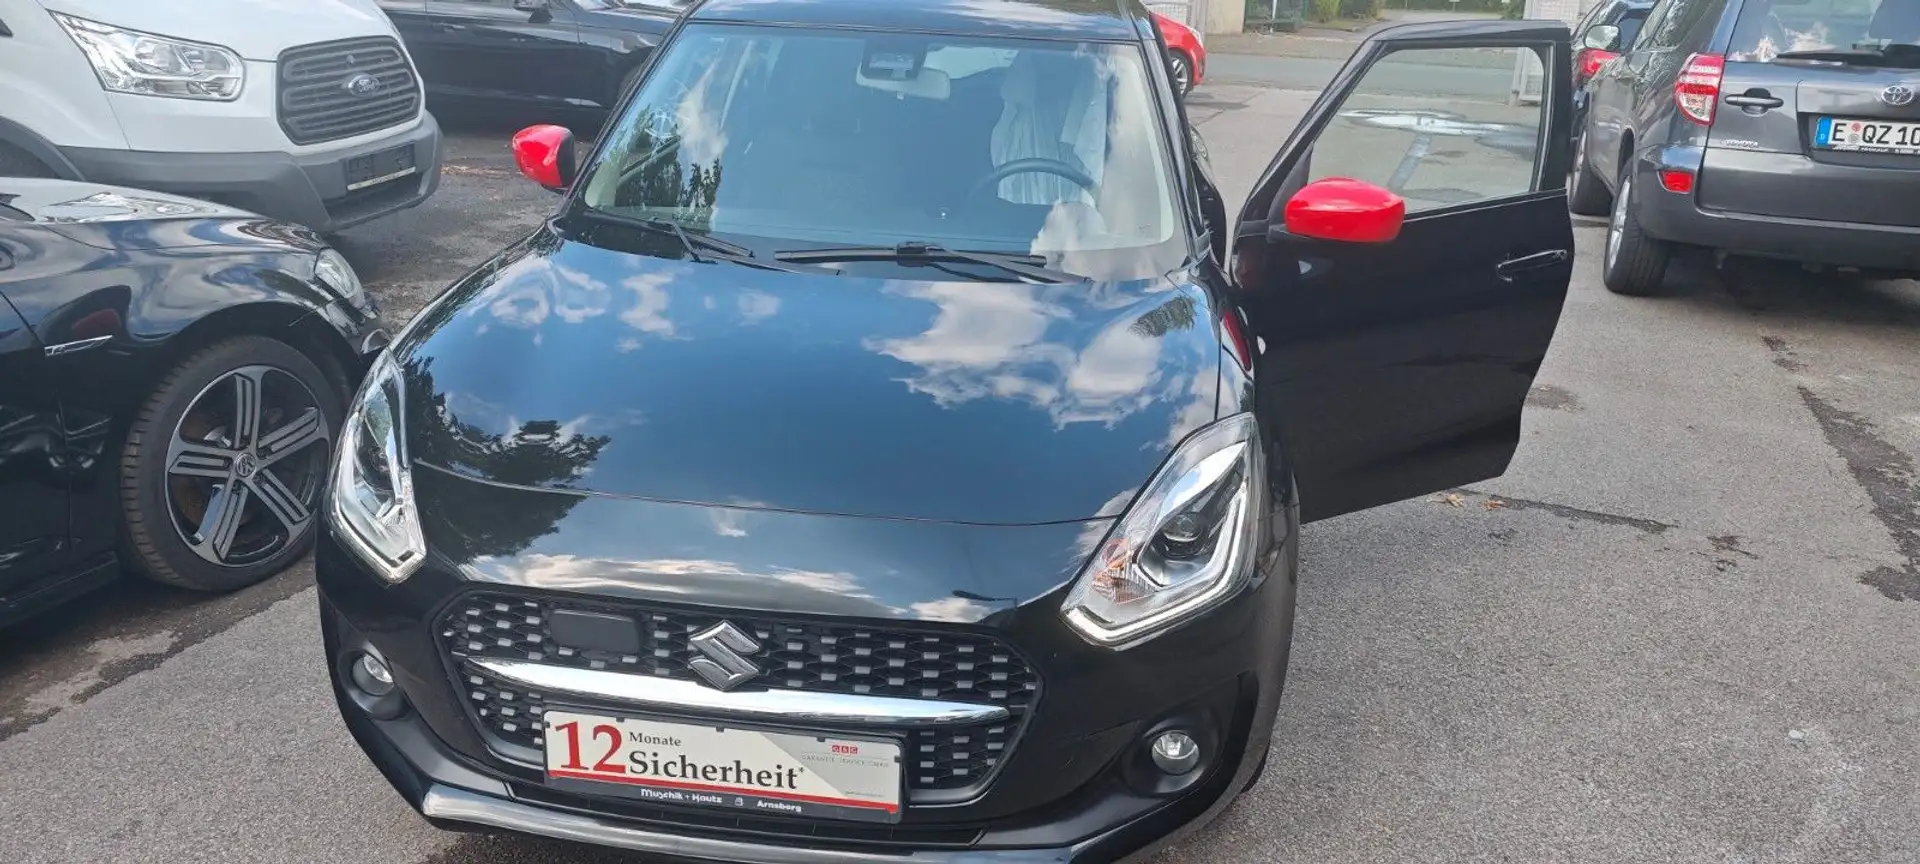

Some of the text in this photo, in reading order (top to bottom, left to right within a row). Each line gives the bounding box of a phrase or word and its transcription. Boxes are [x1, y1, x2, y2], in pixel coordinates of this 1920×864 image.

[1832, 123, 1847, 142] E
[1862, 125, 1893, 144] QZ
[555, 721, 627, 774] 12
[629, 732, 682, 747] Monate
